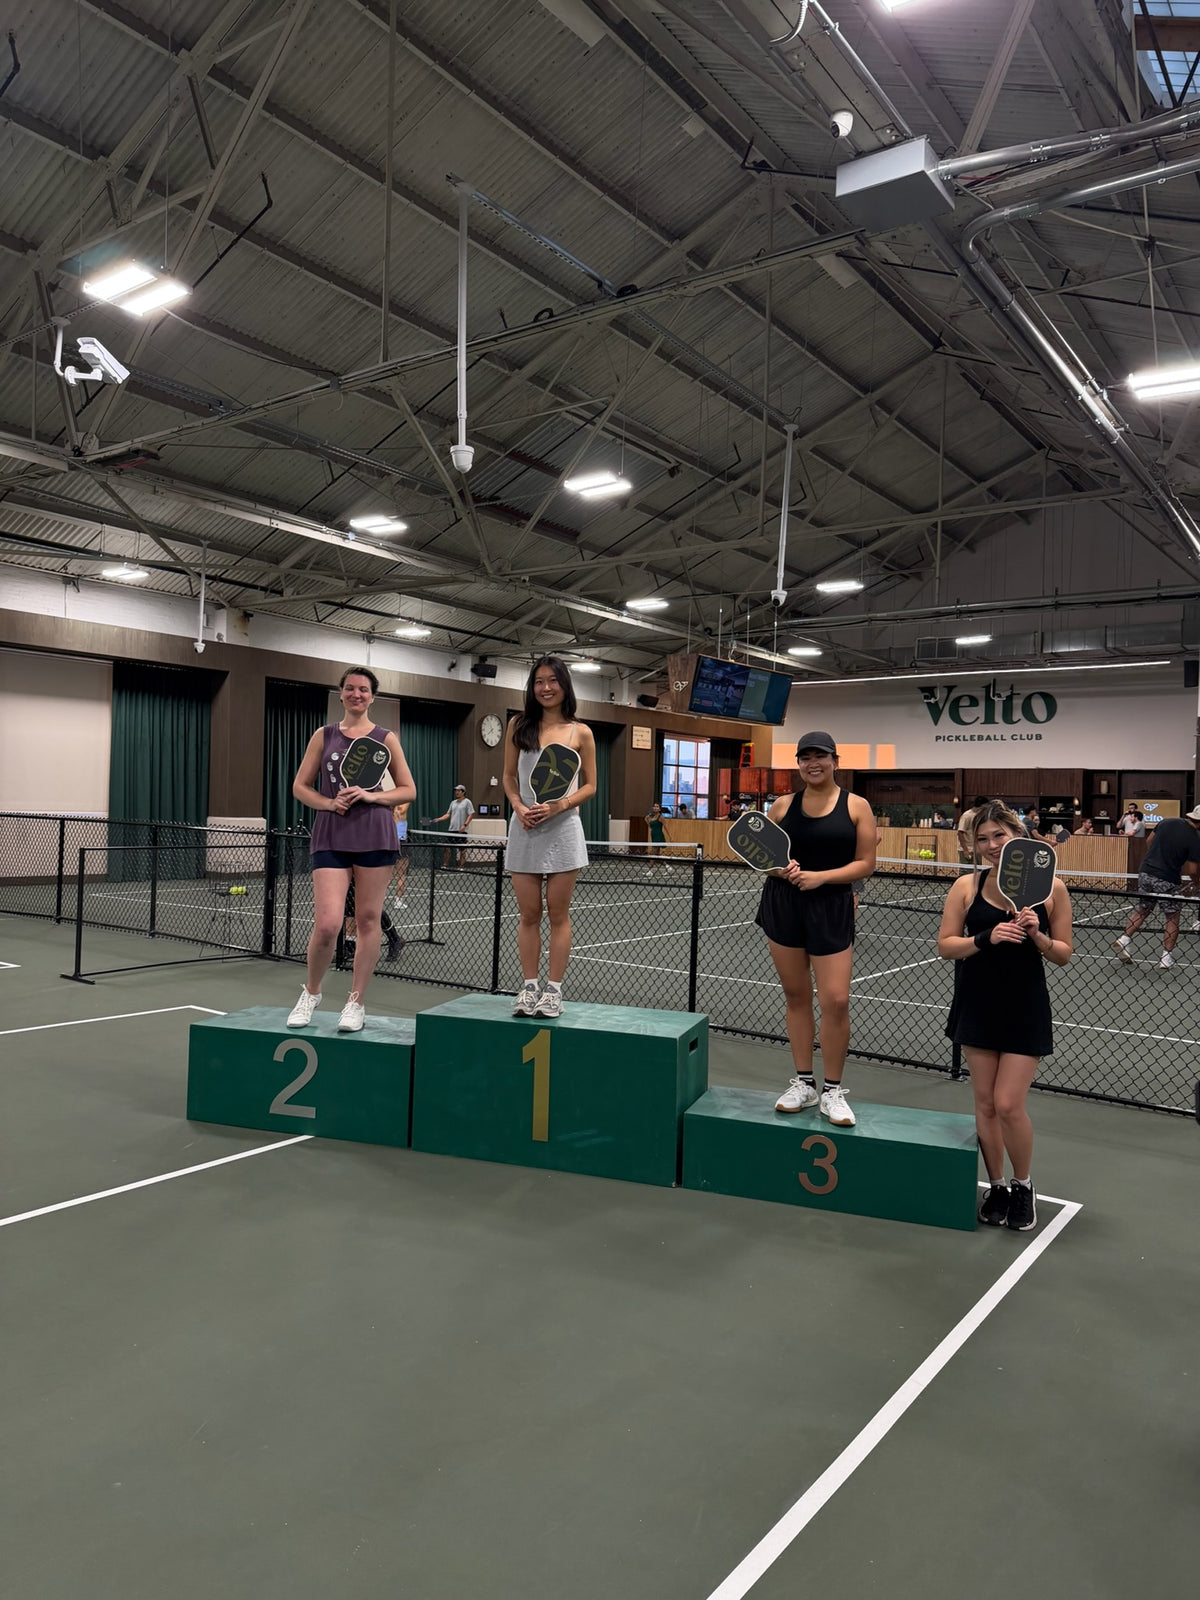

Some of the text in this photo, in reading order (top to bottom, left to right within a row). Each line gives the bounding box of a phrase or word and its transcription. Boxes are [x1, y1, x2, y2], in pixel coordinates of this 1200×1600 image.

[917, 682, 1058, 726] Velto
[935, 733, 1043, 743] PICKLEBALL CLUB
[269, 1038, 318, 1119] 2
[522, 1028, 551, 1142] 1
[798, 1134, 838, 1195] 3
